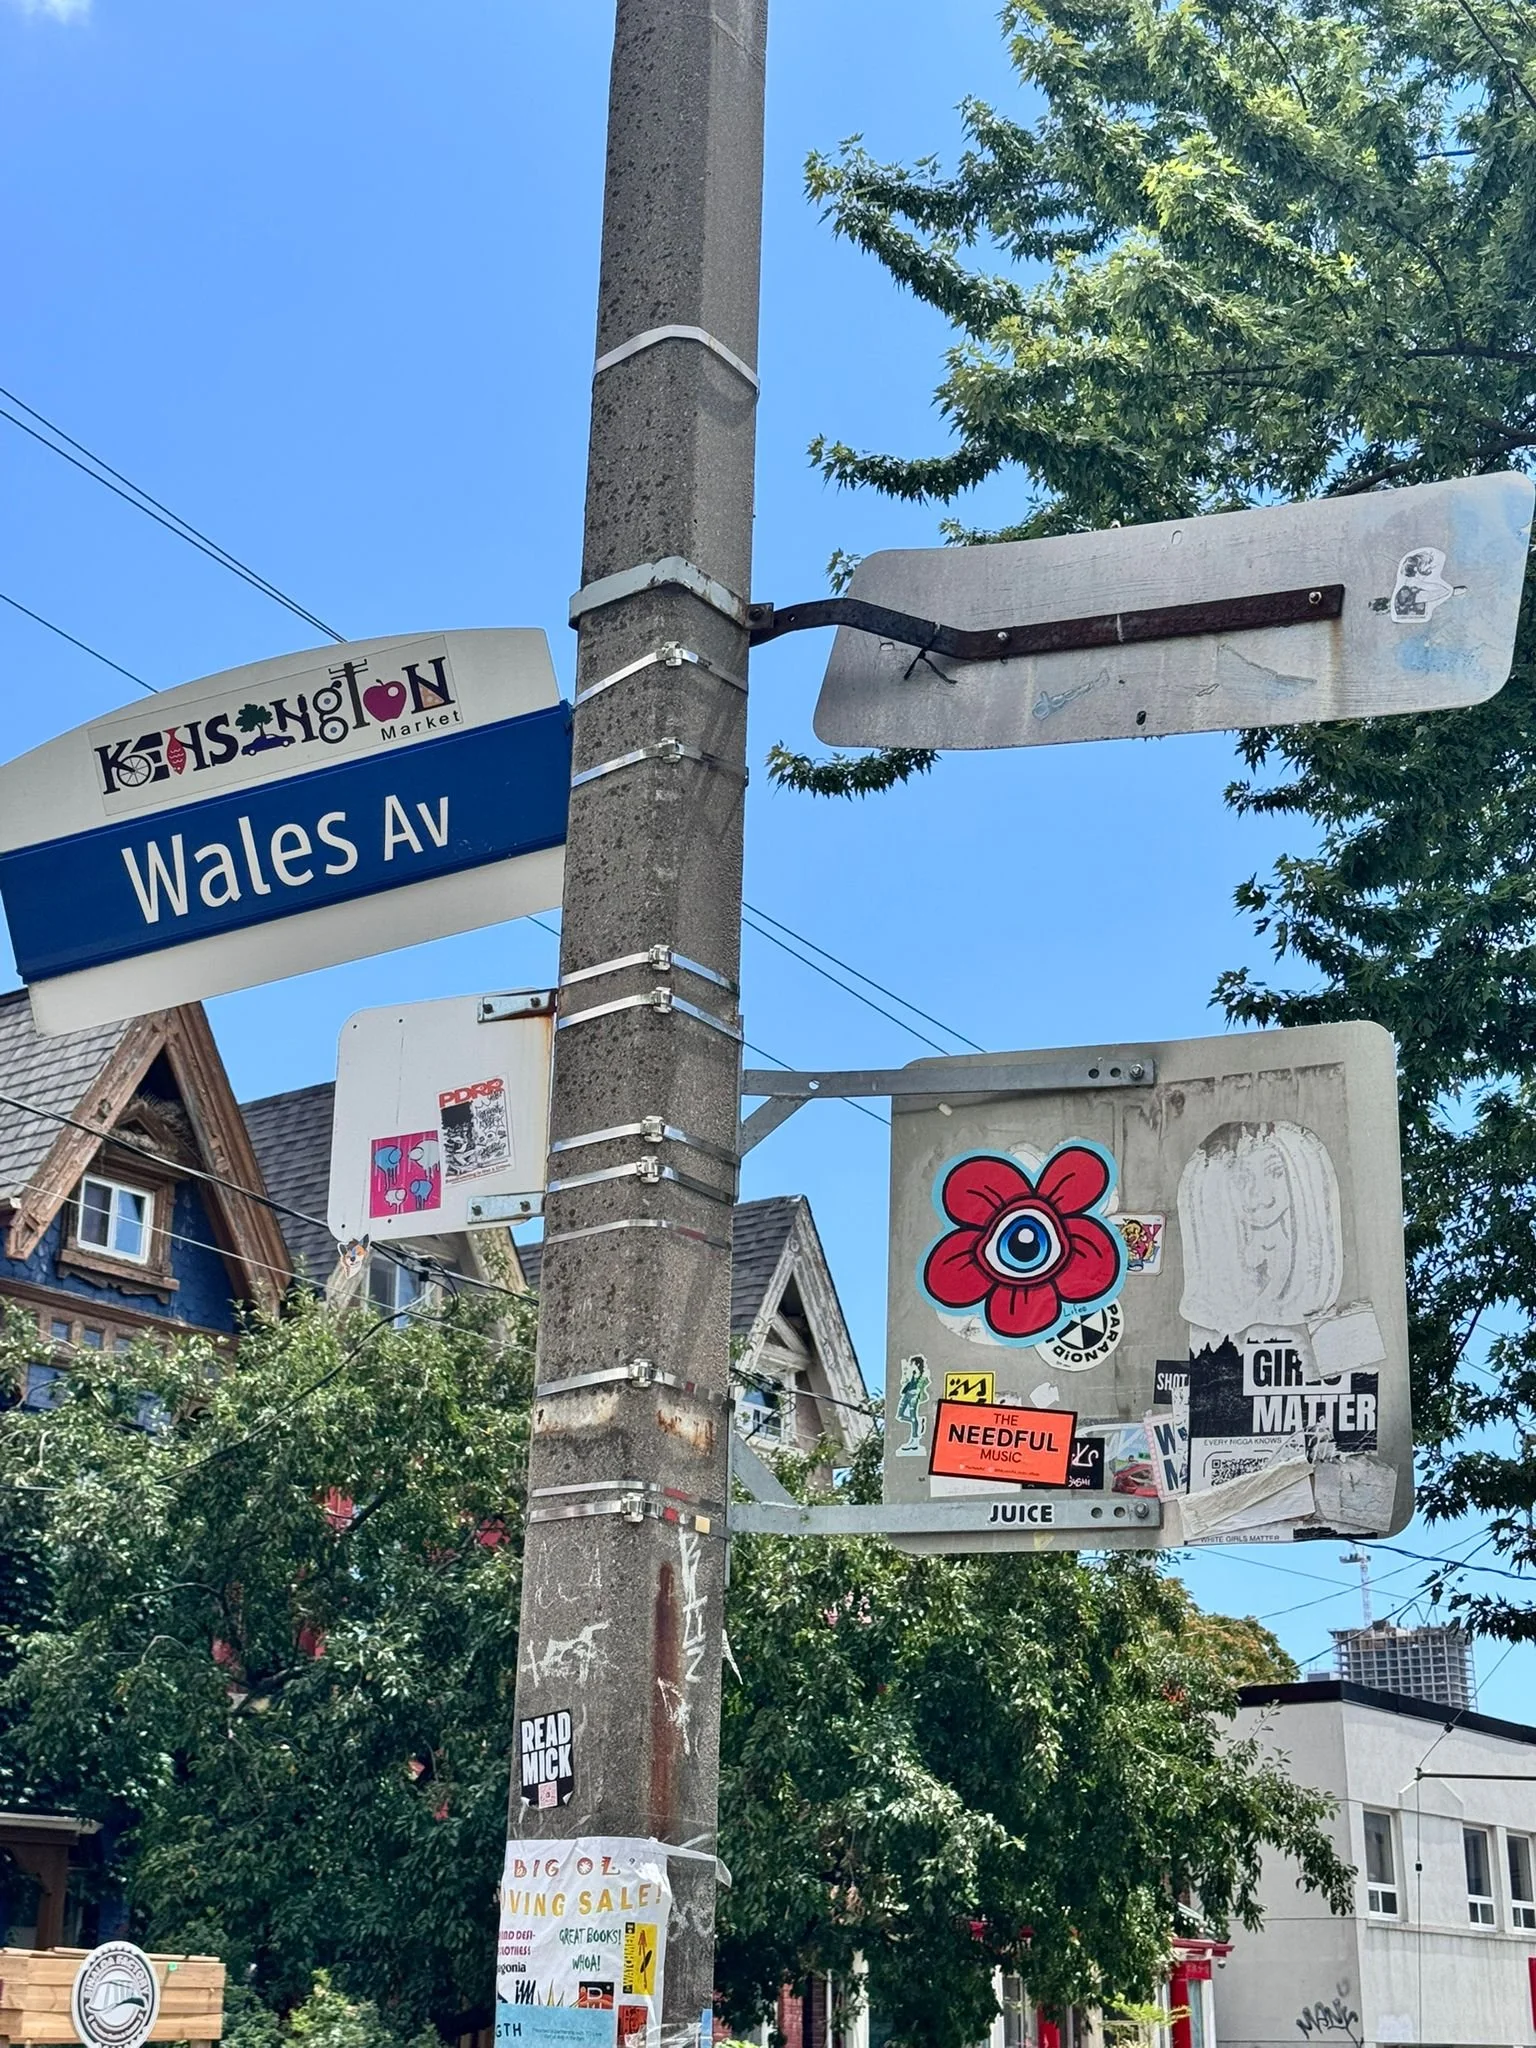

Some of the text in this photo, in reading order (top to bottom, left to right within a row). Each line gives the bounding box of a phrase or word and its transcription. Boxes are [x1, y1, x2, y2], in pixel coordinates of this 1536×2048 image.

[380, 709, 462, 742] Market
[121, 811, 359, 924] Wales
[1253, 1348, 1342, 1387] GIR
[993, 1412, 1020, 1426] THE
[1252, 1393, 1377, 1434] MATTER
[948, 1423, 1059, 1452] NEEDFUL
[980, 1448, 1022, 1464] MUSIC
[990, 1504, 1053, 1523] JUICE
[521, 1711, 571, 1751] READ
[522, 1743, 573, 1787] MICK
[513, 1858, 560, 1879] BIG
[578, 1883, 662, 1916] SALE!
[559, 1927, 621, 1945] GREAT BOOKS!
[572, 1954, 601, 1972] WHOA!
